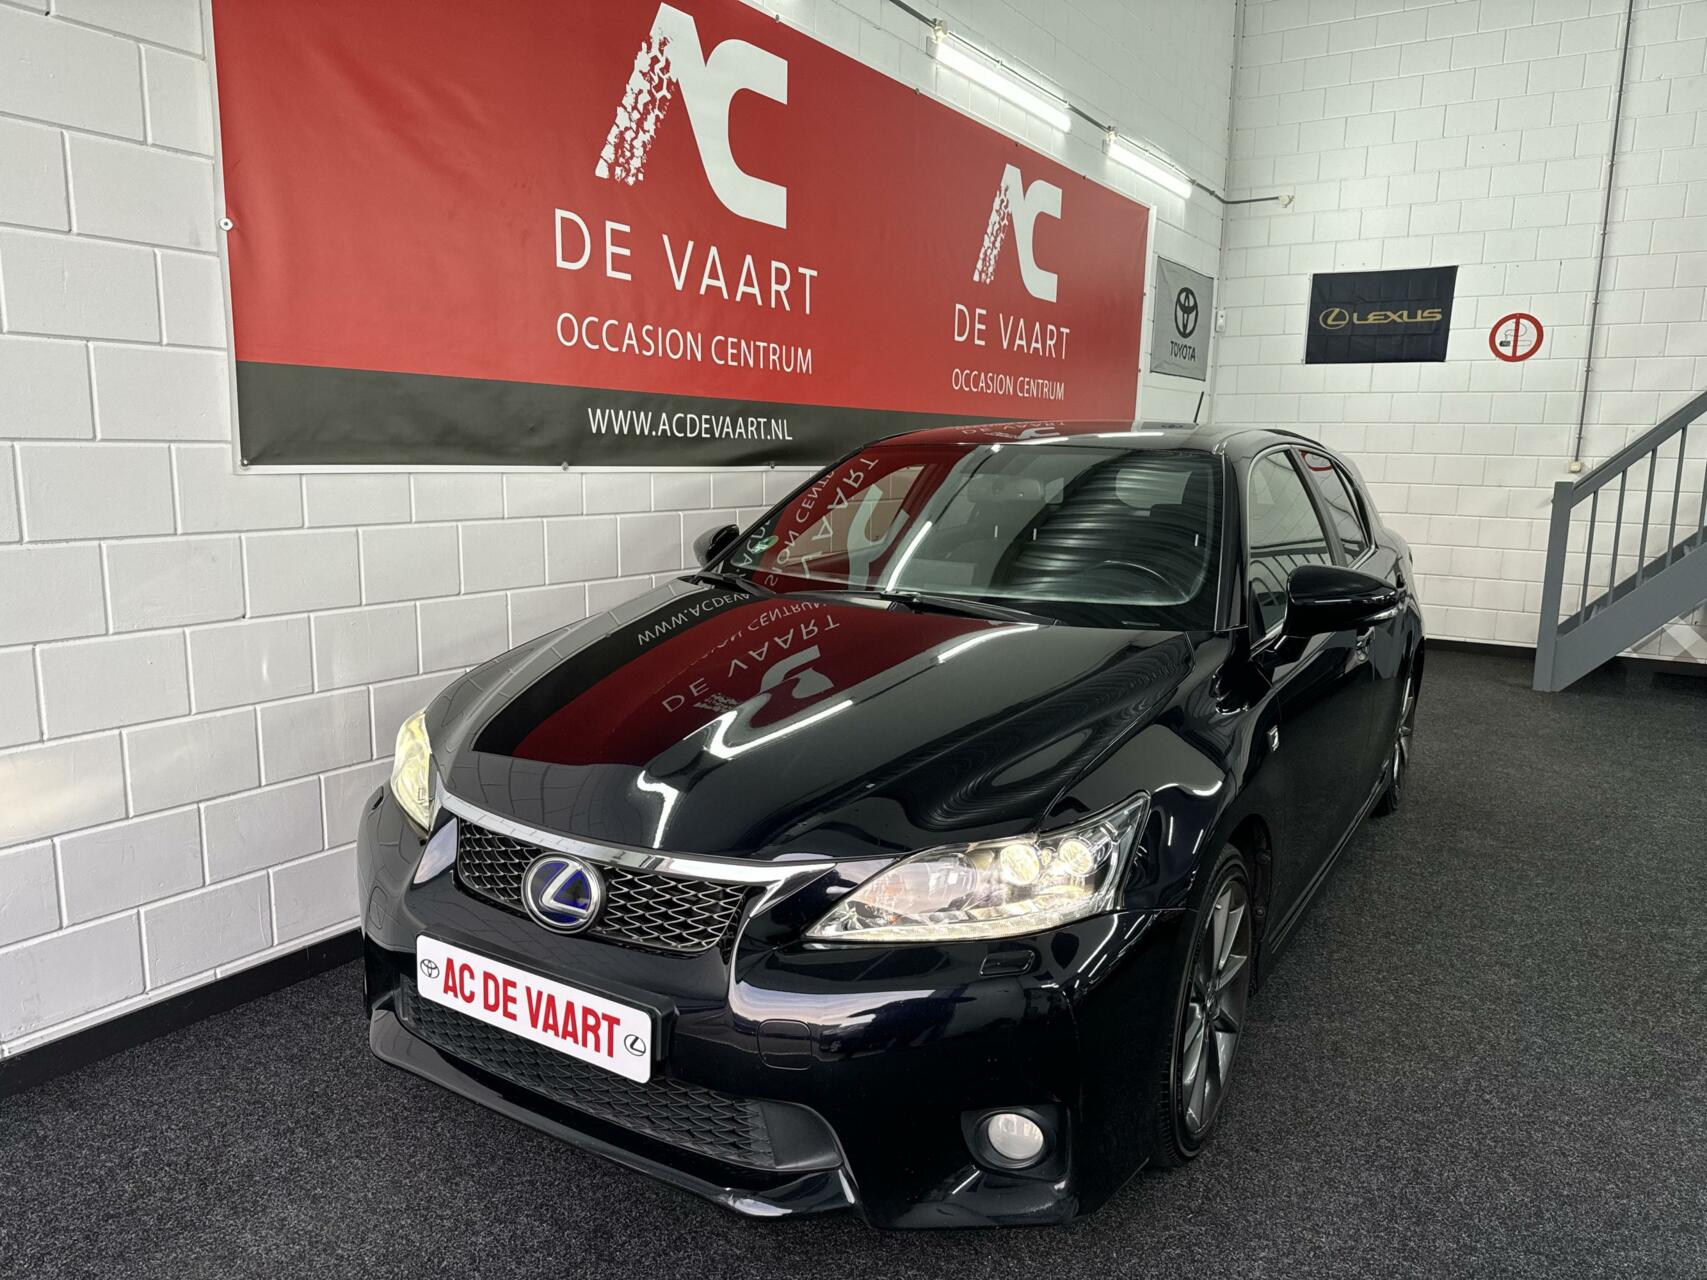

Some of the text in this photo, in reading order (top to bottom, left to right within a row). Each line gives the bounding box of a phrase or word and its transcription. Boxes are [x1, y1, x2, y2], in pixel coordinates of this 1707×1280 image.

[554, 208, 818, 315] DE VAART
[954, 303, 1070, 360] DE VAART
[1352, 308, 1443, 325] LEXUS
[556, 312, 813, 375] OCCASION CENTRUM
[1170, 341, 1196, 362] TOYOTA
[952, 368, 1065, 401] OCCASION CENTRUM
[587, 407, 793, 440] WWW.ACDEVAART.NL
[443, 957, 621, 1058] AC DE VAART
